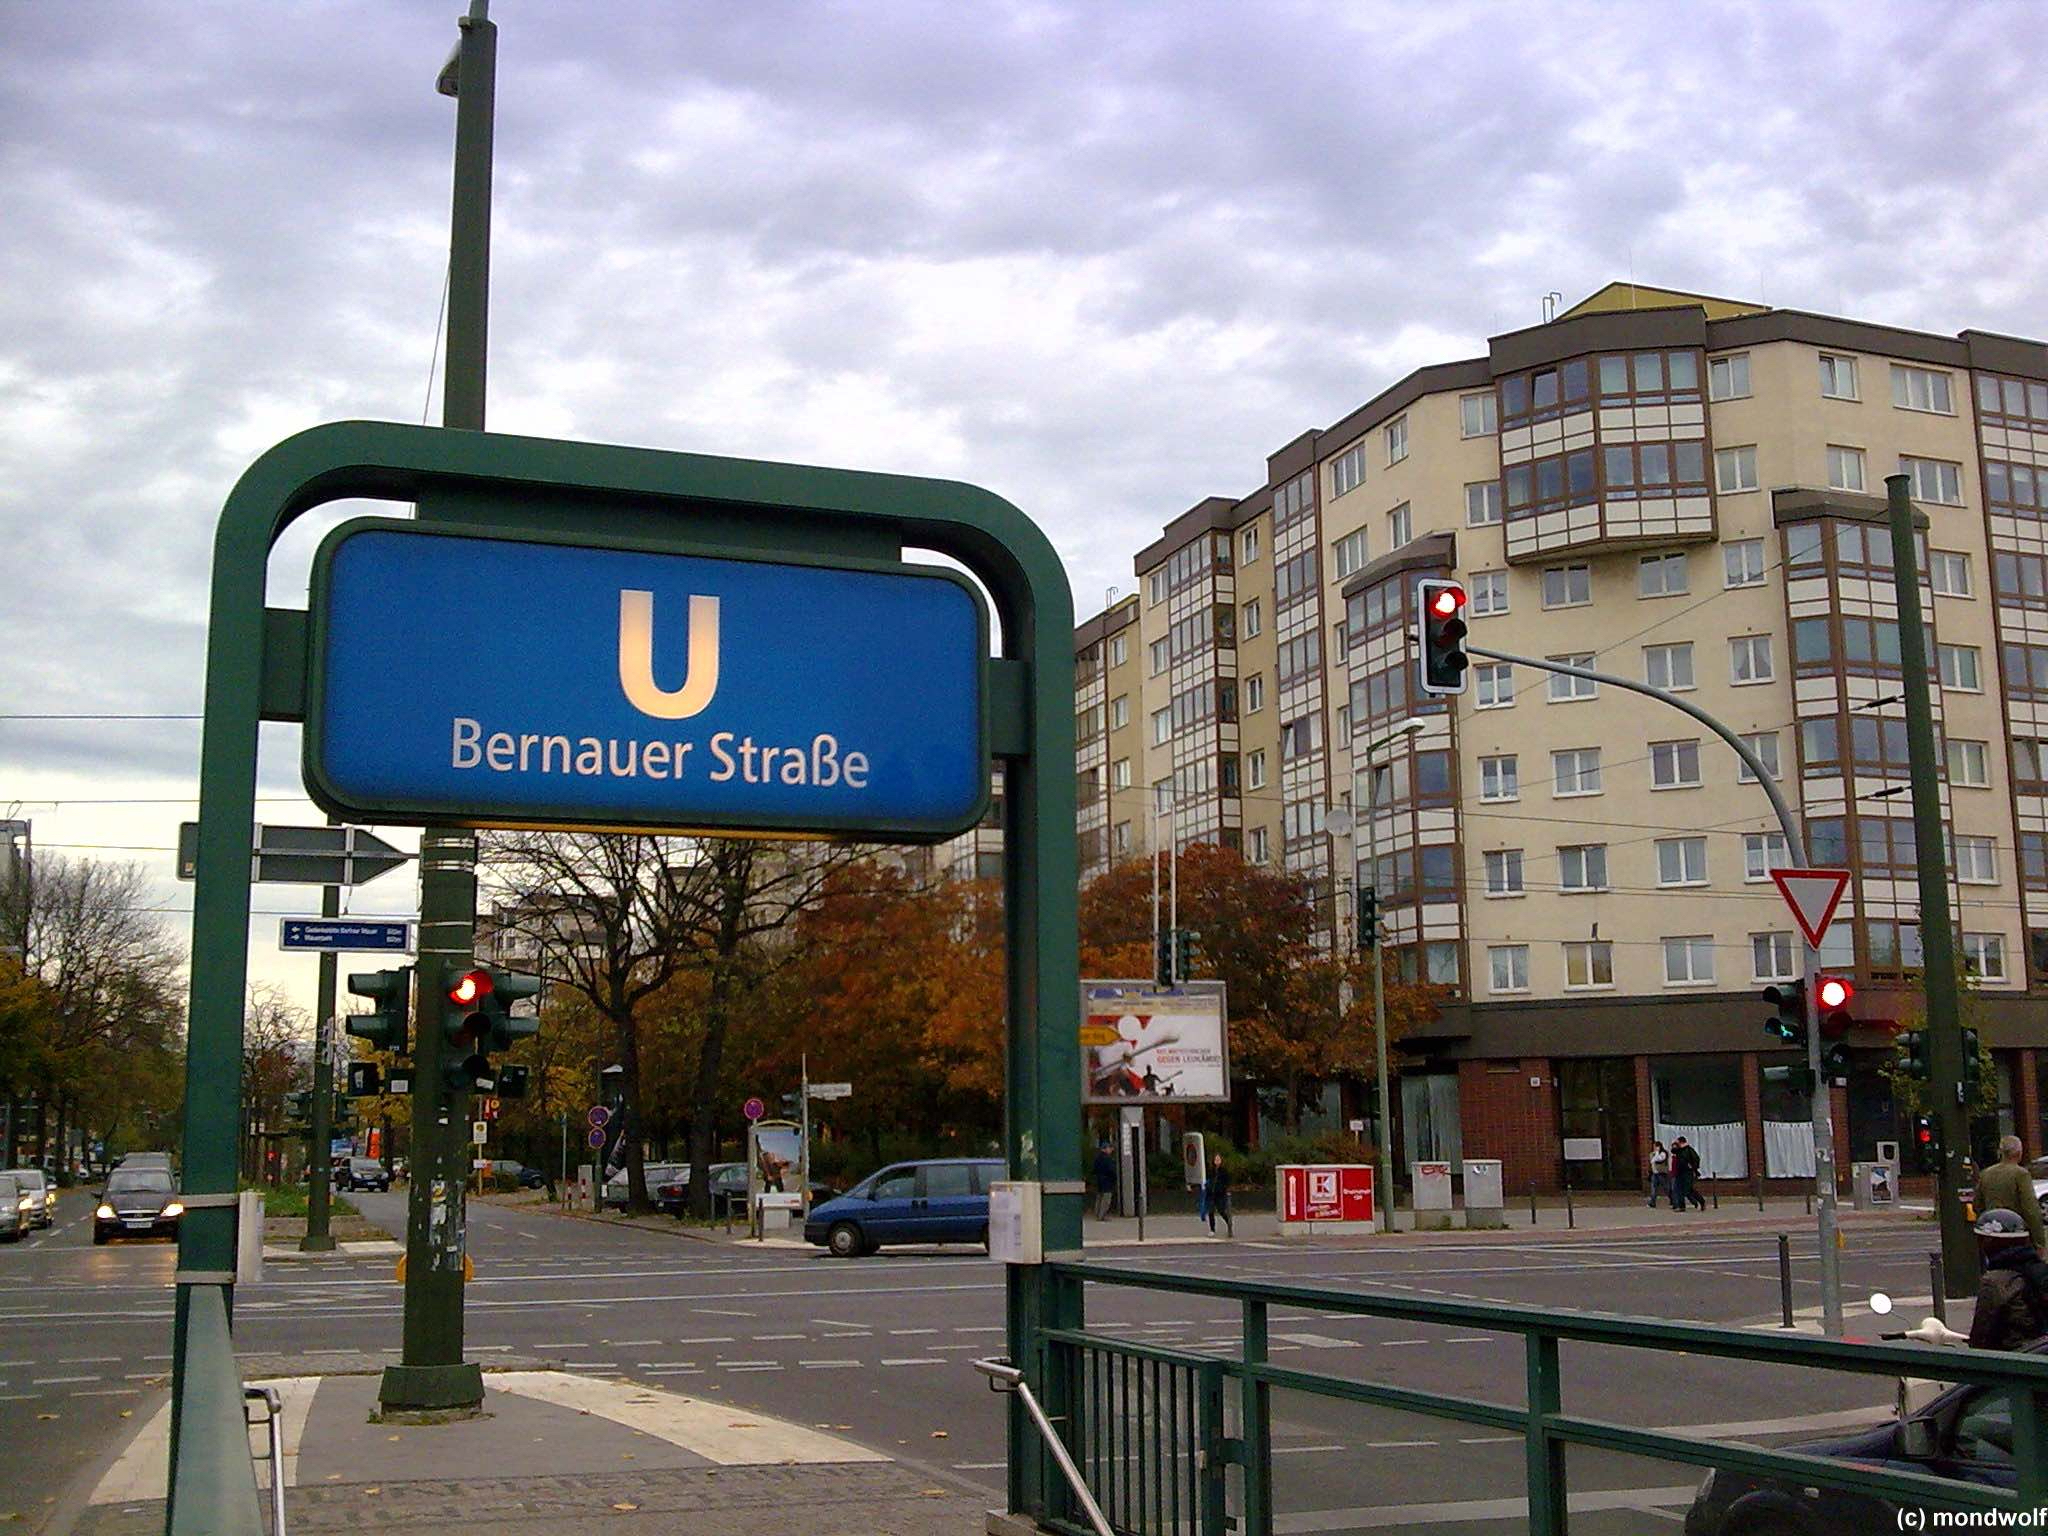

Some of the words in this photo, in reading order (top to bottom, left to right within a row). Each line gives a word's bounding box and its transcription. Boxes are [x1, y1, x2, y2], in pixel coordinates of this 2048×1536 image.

[619, 588, 721, 719] U
[451, 717, 693, 780] Bernauer
[709, 731, 870, 788] Straße
